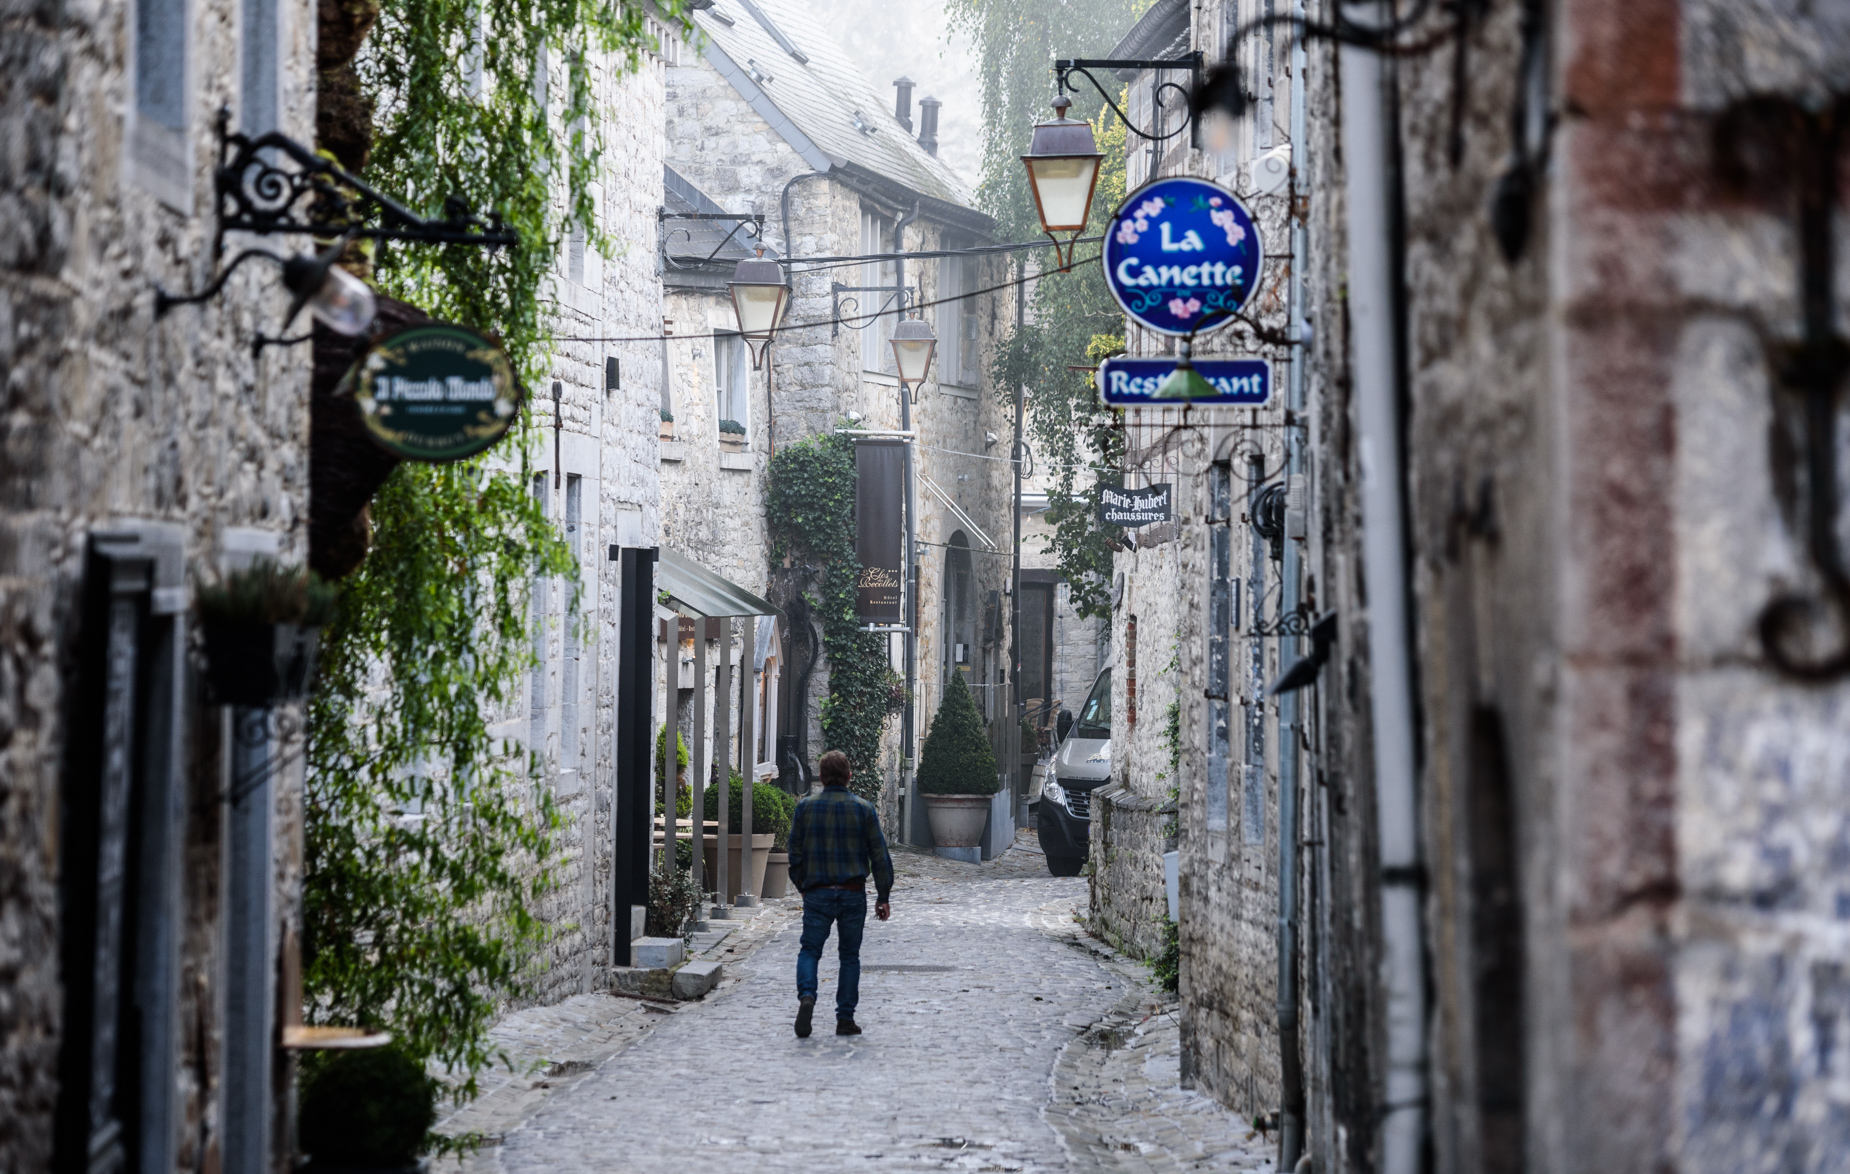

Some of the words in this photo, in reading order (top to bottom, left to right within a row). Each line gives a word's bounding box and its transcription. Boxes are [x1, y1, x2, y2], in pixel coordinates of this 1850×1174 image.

[1159, 221, 1205, 252] La
[1116, 257, 1243, 287] Canette
[1100, 488, 1168, 511] Marie-Hubert
[1105, 507, 1165, 521] chaussures
[868, 567, 889, 580] Clos
